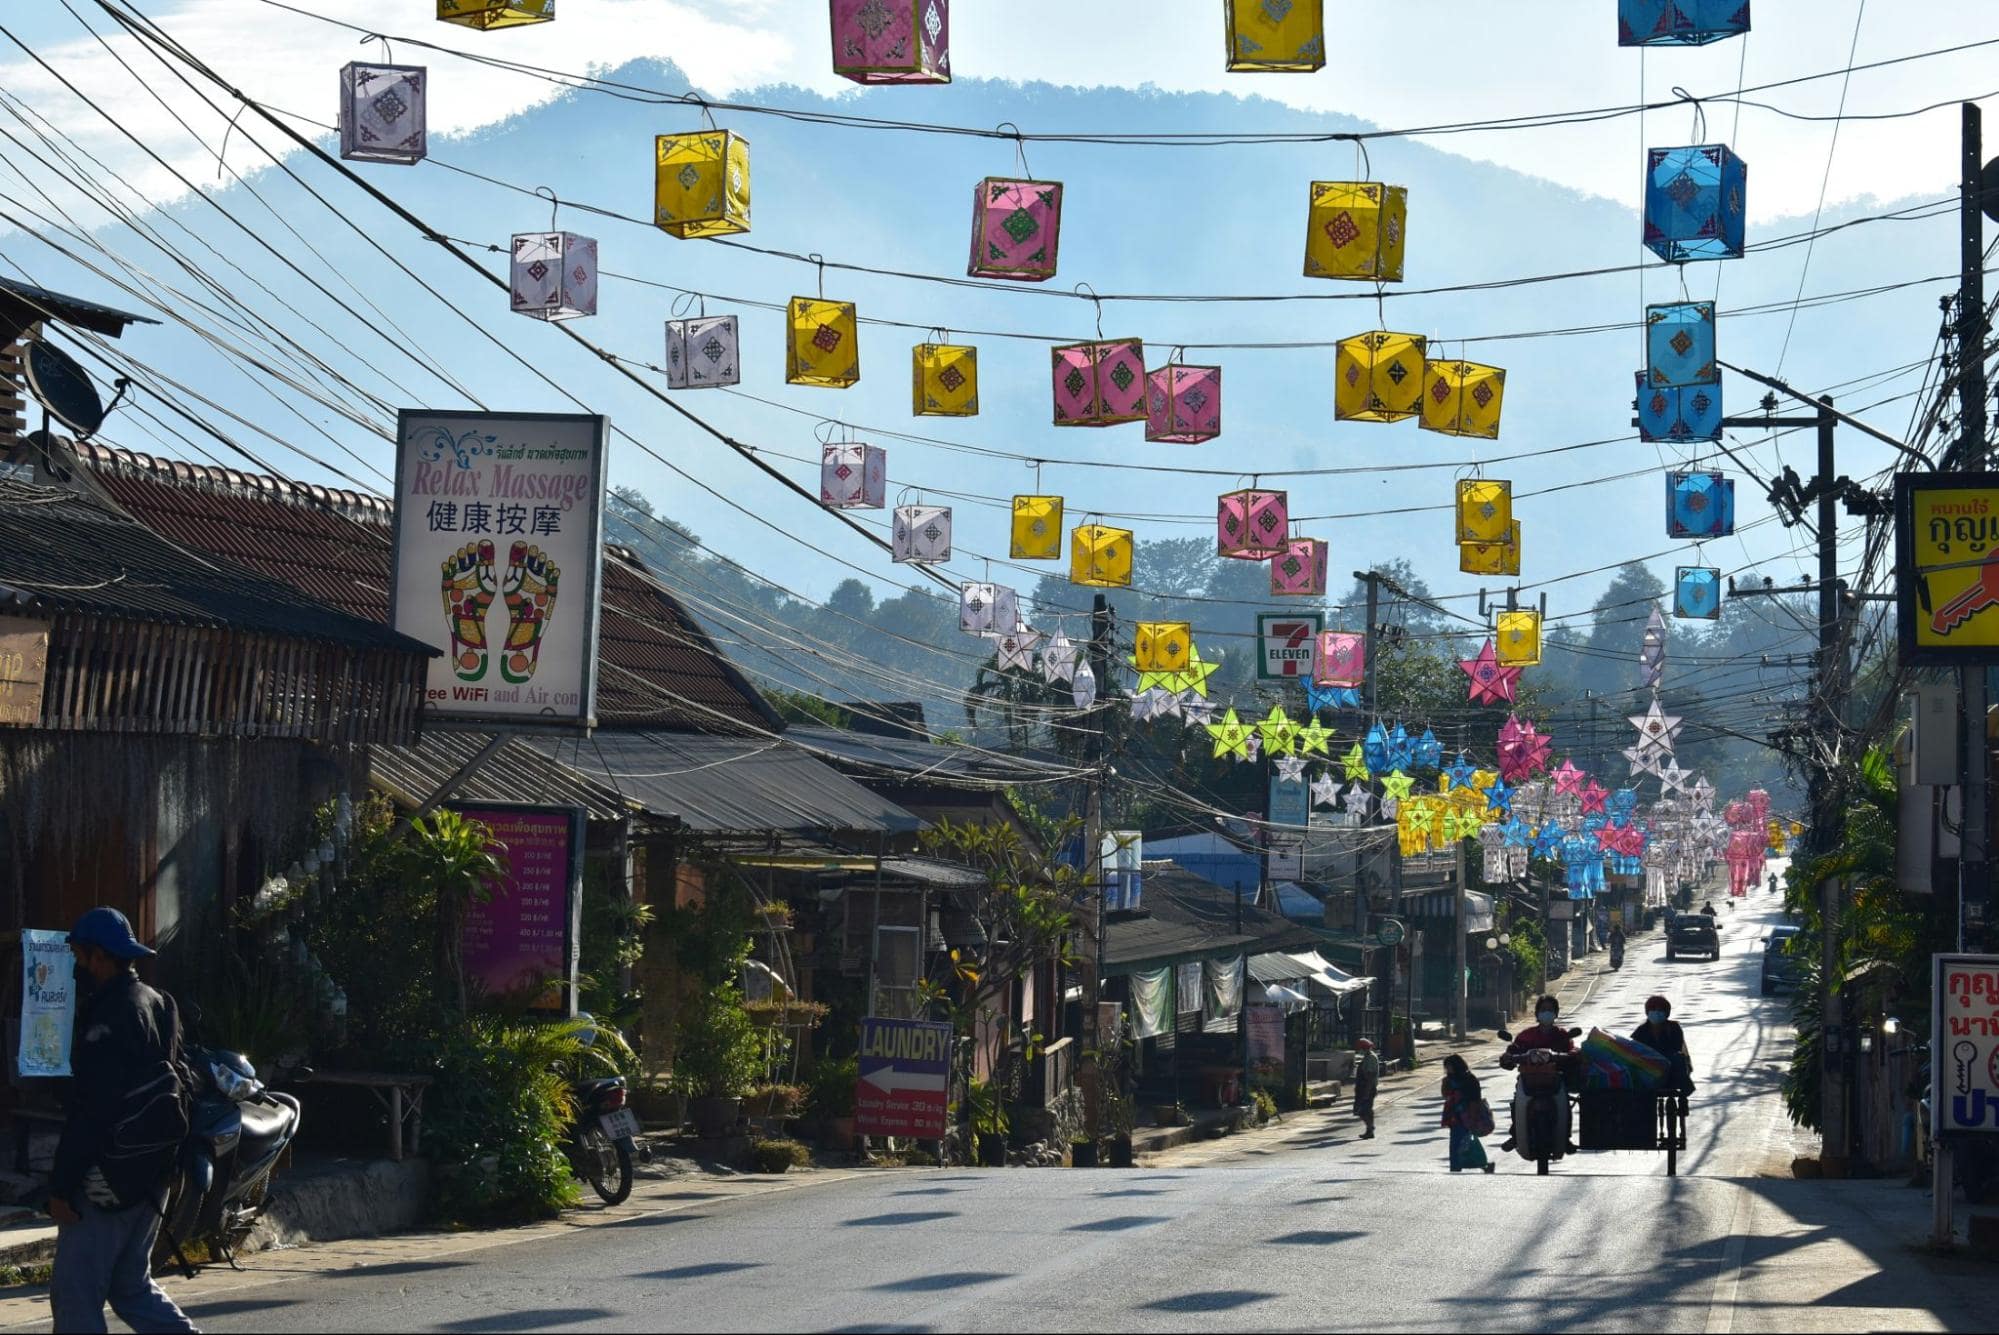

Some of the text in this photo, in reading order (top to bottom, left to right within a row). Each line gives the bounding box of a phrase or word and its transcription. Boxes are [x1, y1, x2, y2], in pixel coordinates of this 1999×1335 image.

[411, 459, 588, 512] Relax Massage
[426, 499, 562, 537] 健康按摩
[1272, 623, 1309, 675] 7
[452, 686, 489, 702] WiFi
[494, 686, 520, 704] and
[525, 687, 549, 705] Air
[553, 691, 578, 706] con
[863, 1025, 949, 1061] LAUNDRY
